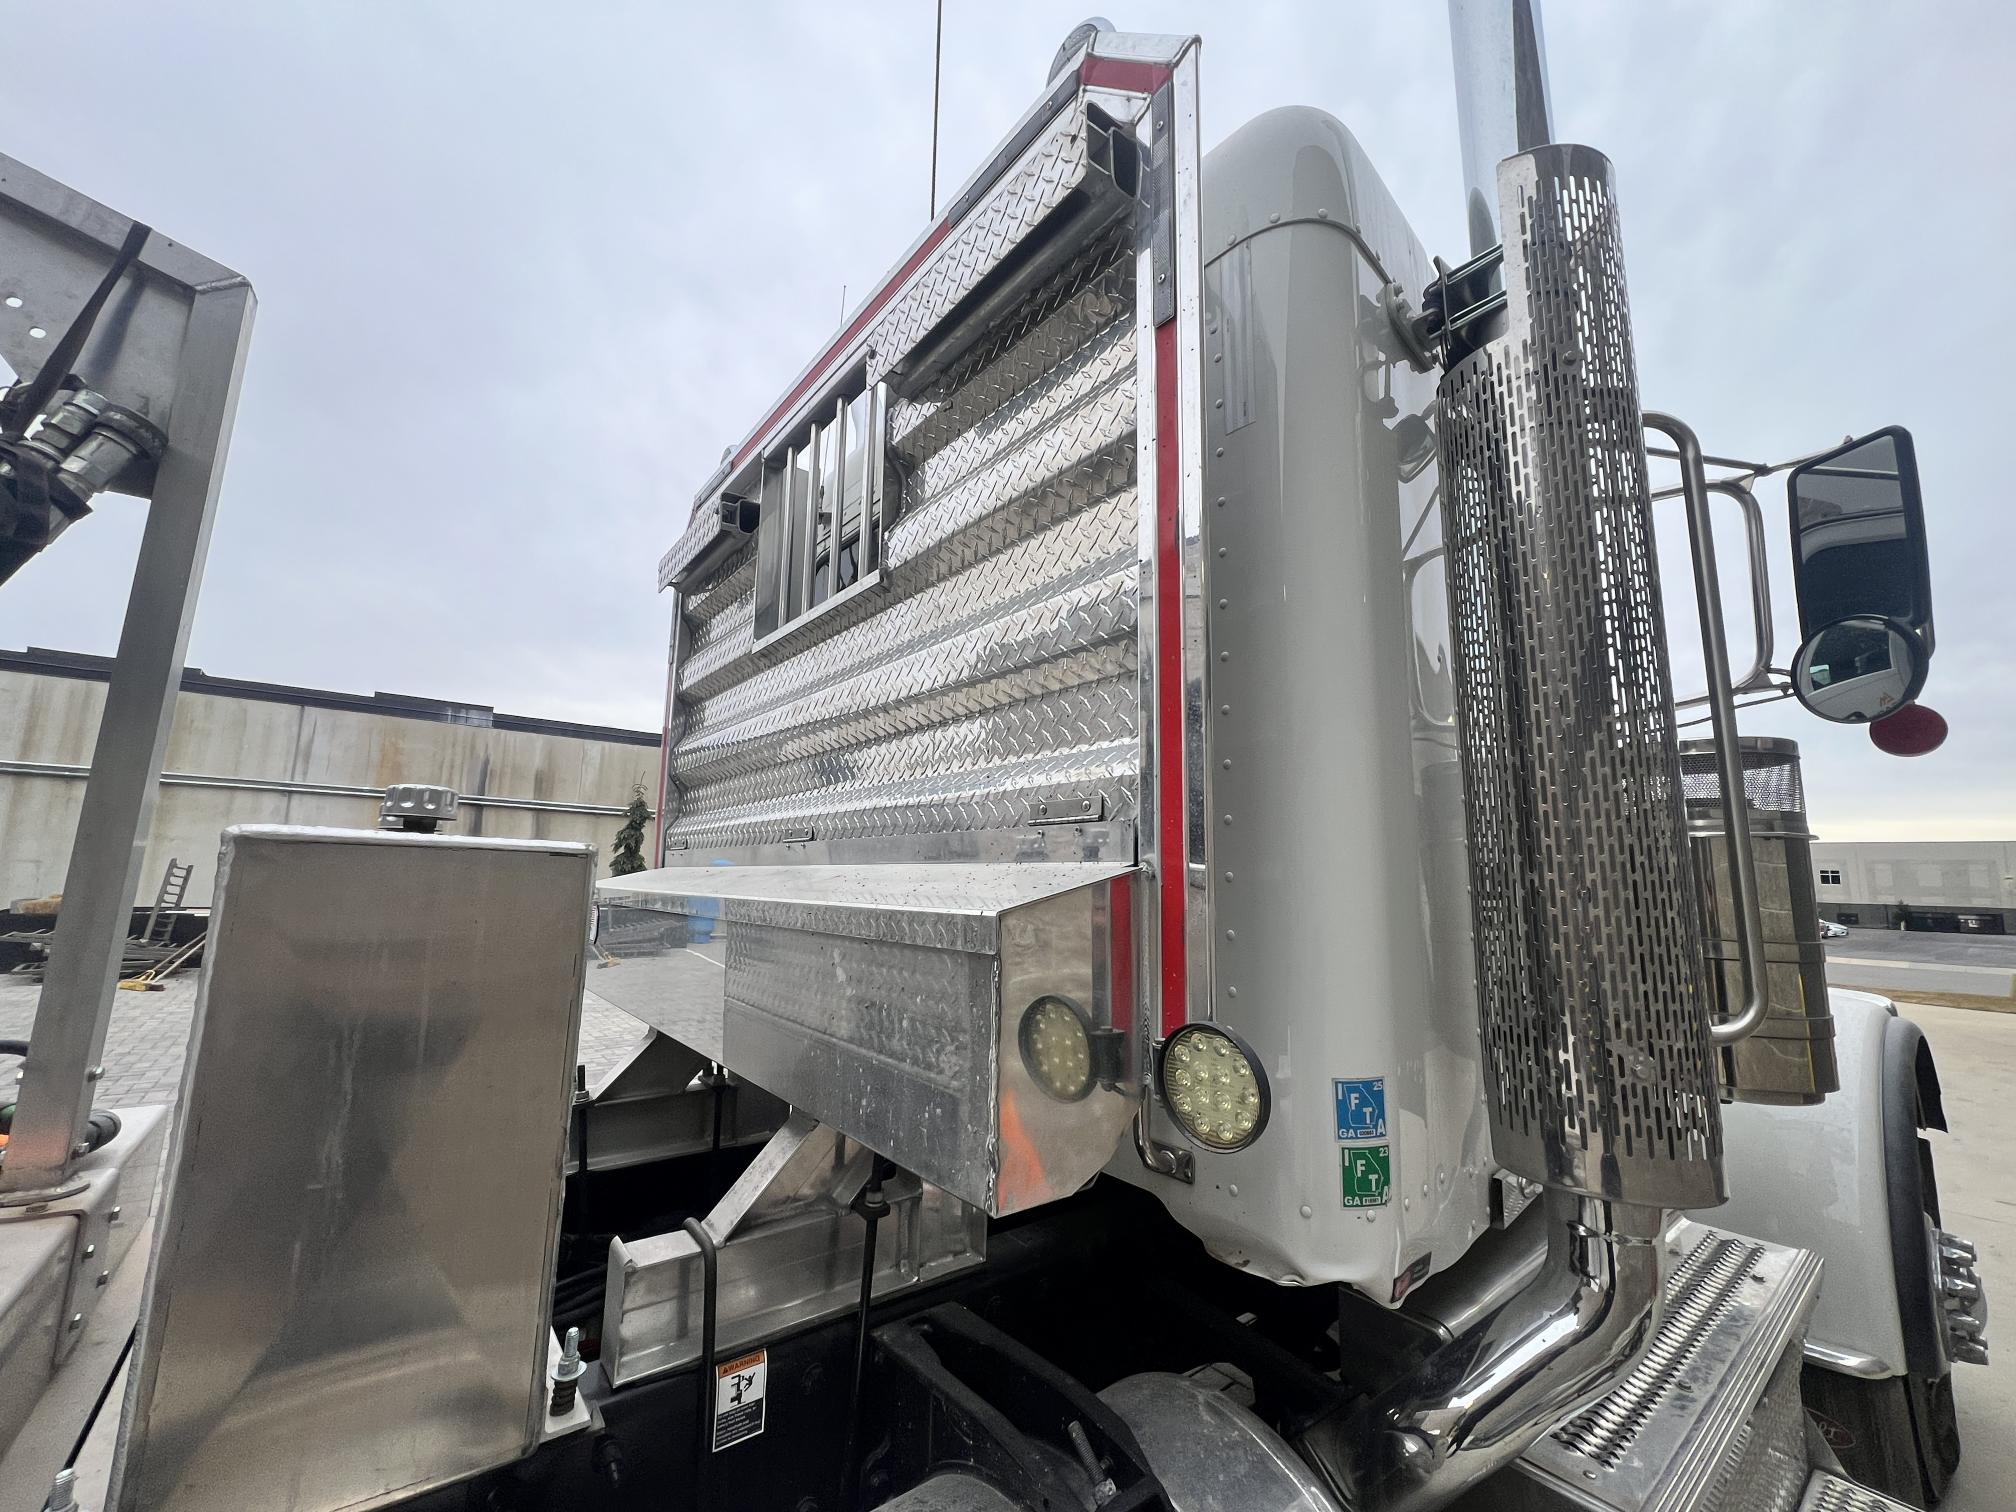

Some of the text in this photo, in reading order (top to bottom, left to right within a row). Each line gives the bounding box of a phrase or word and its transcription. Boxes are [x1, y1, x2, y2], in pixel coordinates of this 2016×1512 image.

[1372, 1081, 1383, 1091] 25
[1339, 1128, 1356, 1138] GA
[1379, 1147, 1388, 1157] 23
[1344, 1196, 1361, 1206] GA
[728, 1355, 760, 1373] WARNING
